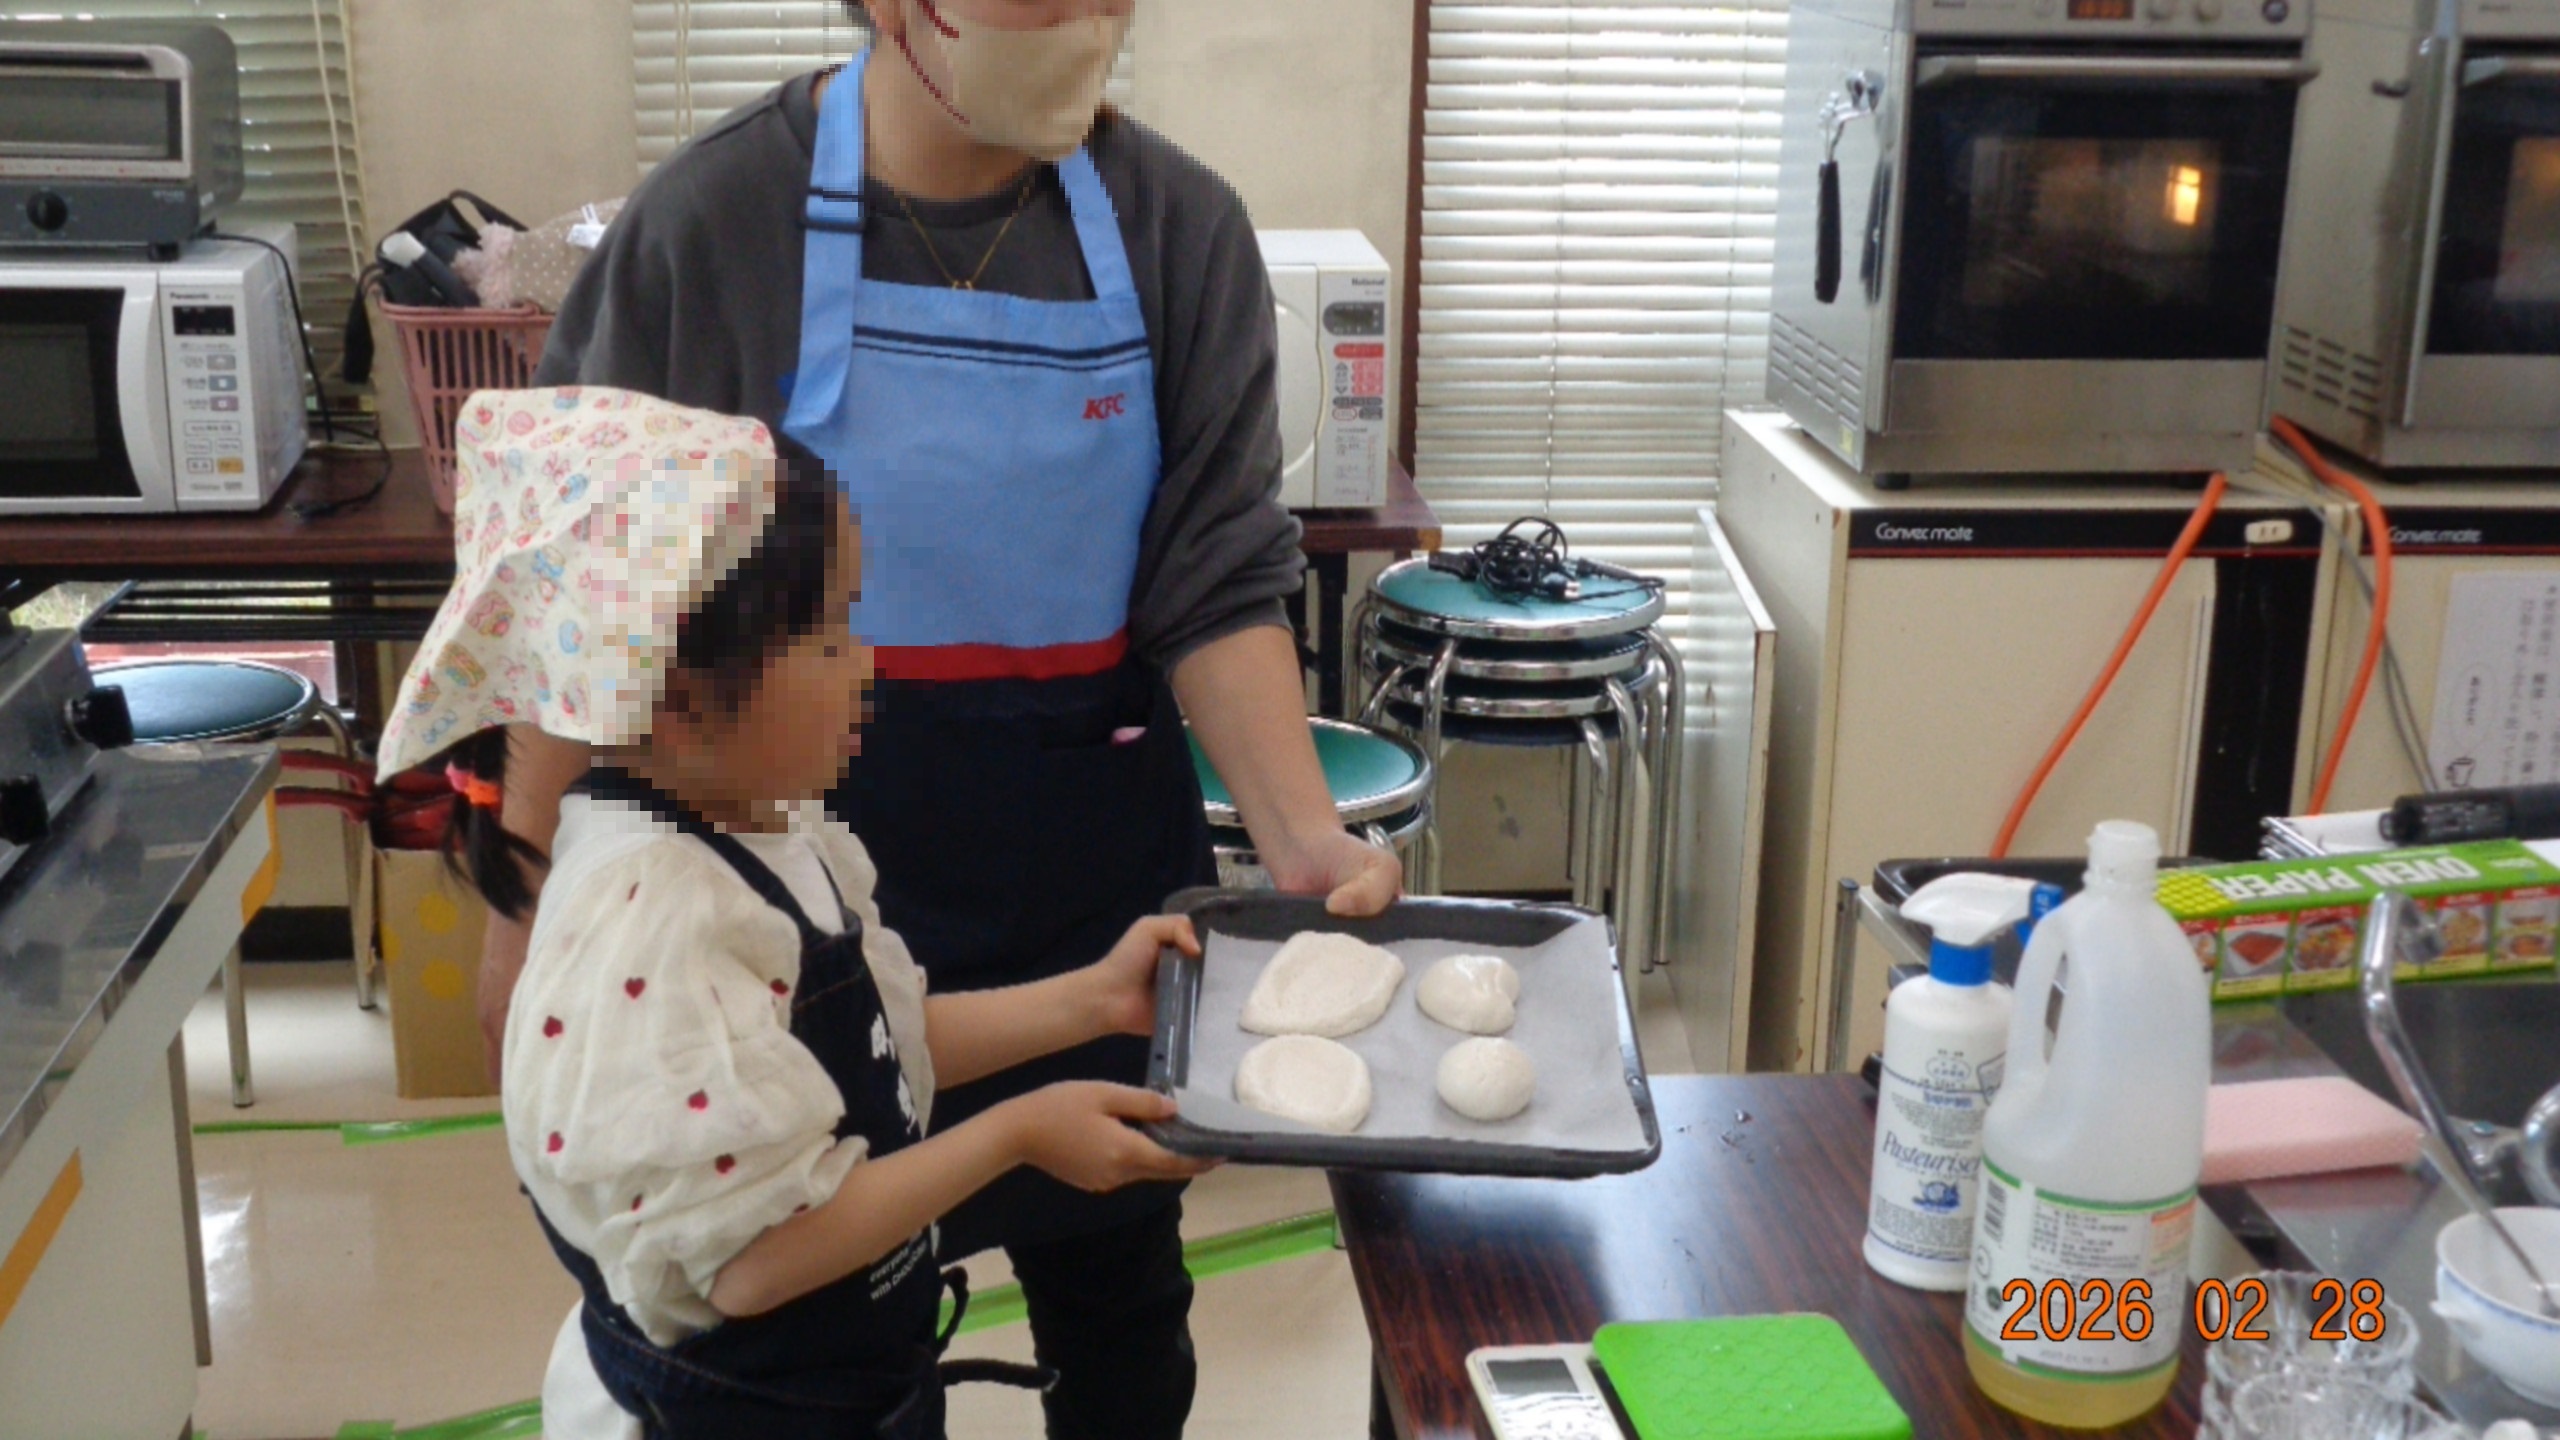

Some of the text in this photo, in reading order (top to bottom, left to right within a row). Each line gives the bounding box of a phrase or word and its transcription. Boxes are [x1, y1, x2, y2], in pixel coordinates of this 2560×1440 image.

[170, 291, 210, 300] Panasonic
[1082, 391, 1126, 420] KFC
[2212, 855, 2481, 901] OVEN PAPER
